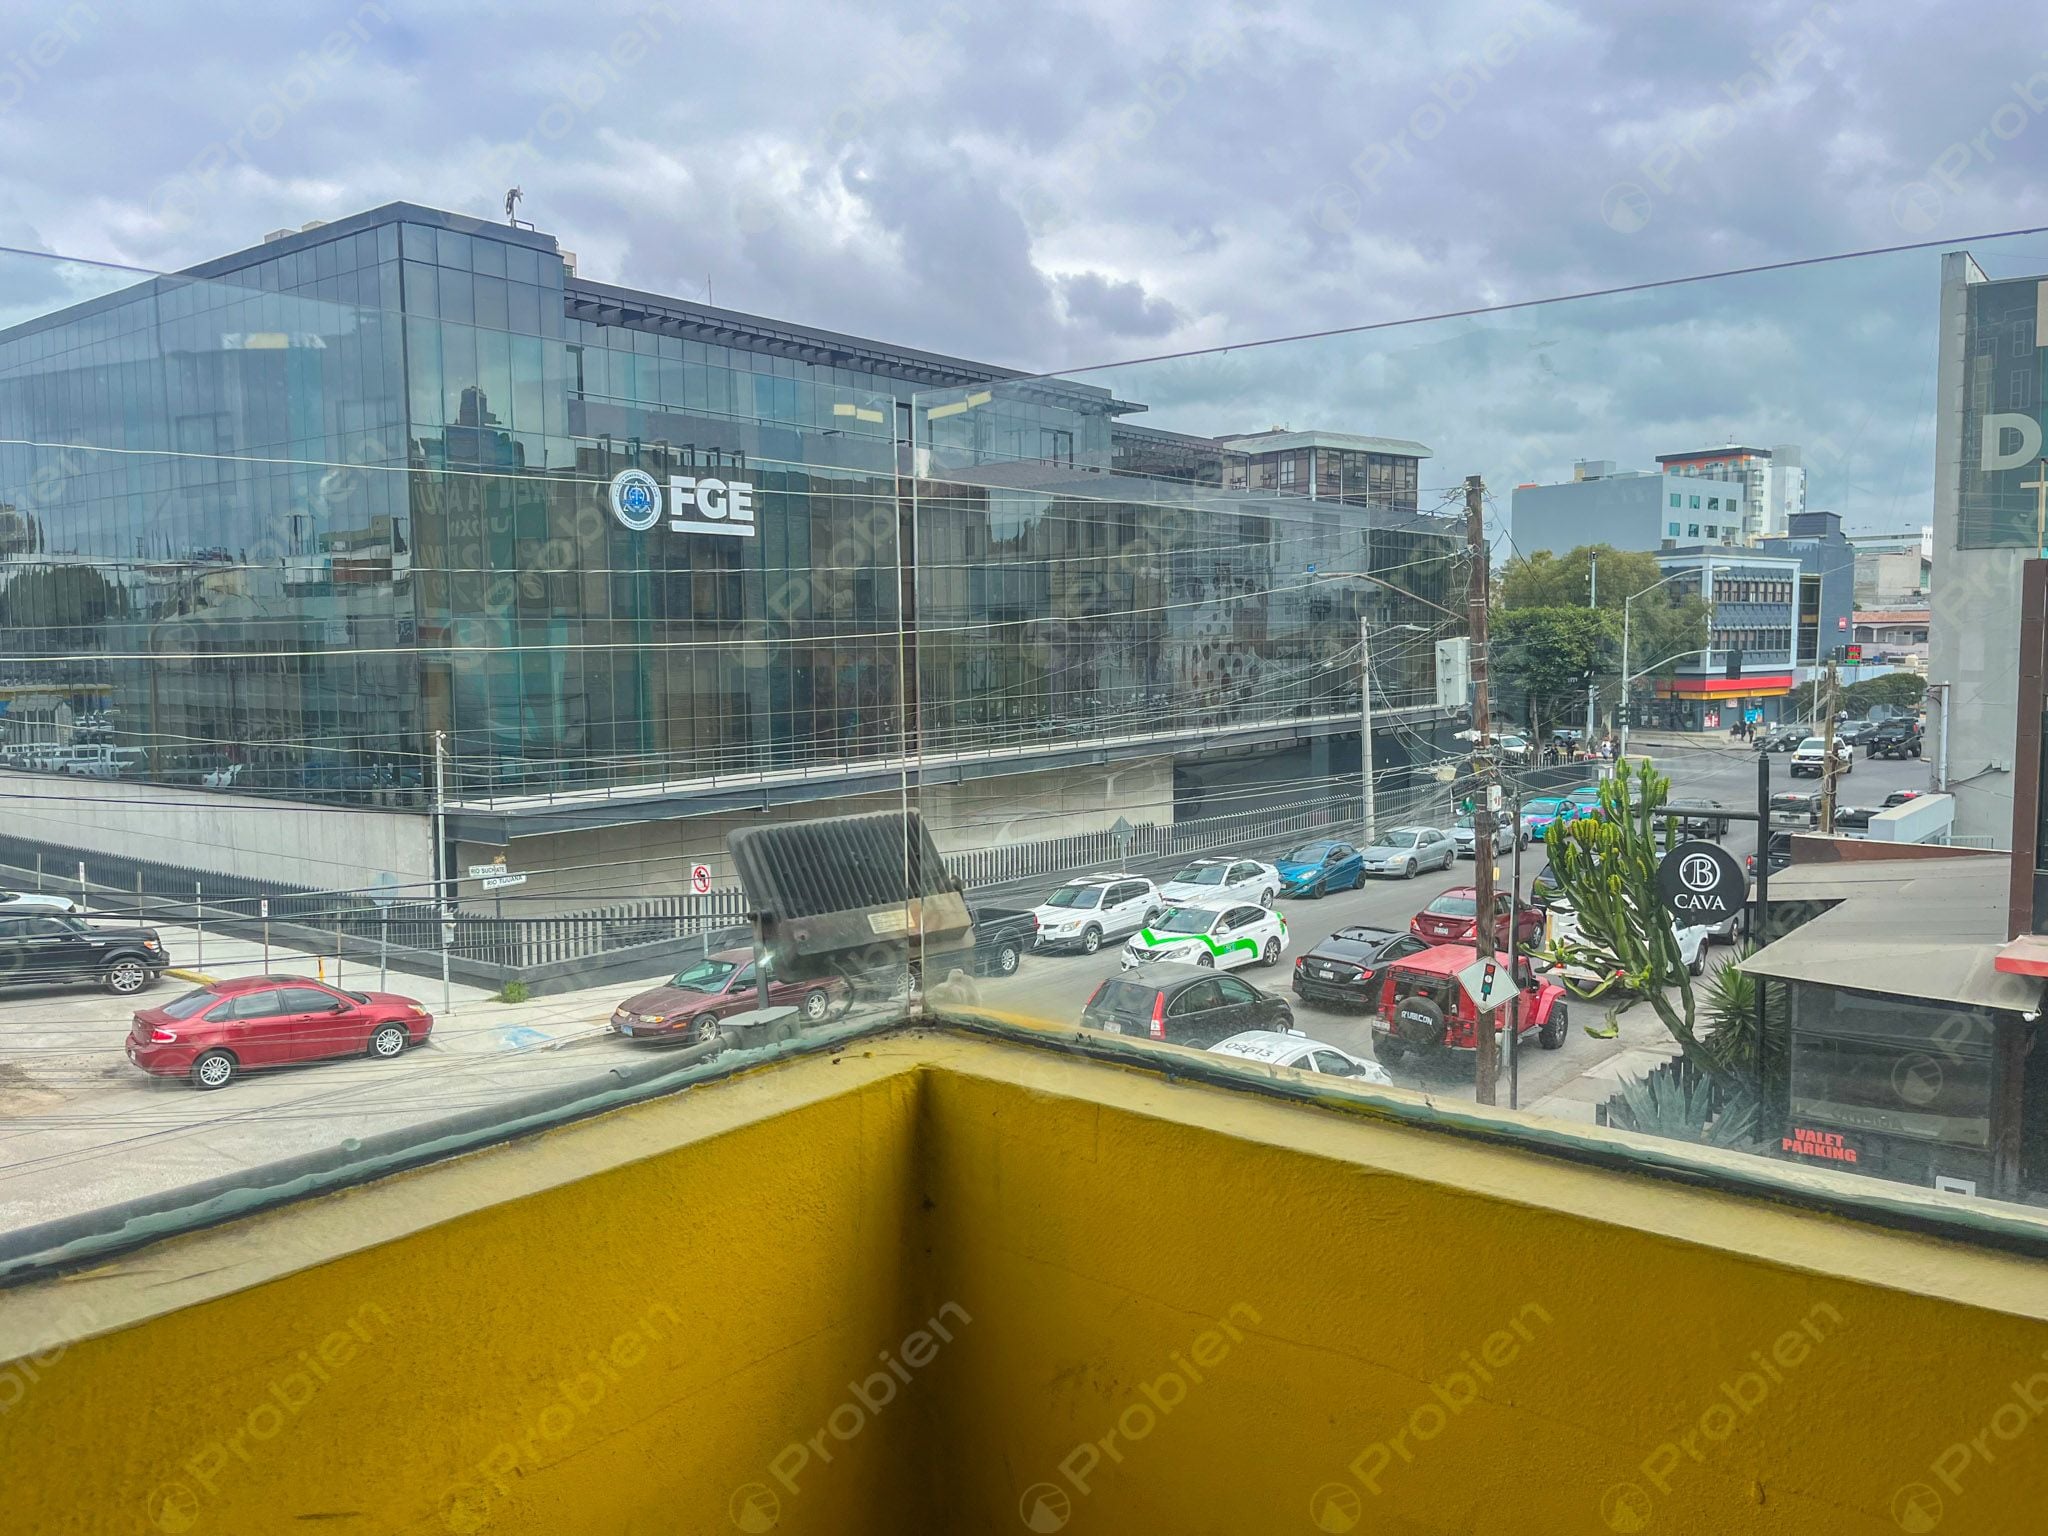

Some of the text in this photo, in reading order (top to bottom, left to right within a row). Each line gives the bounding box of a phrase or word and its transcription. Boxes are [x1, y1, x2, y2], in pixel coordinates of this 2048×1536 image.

[670, 475, 754, 521] FGE
[1674, 894, 1727, 911] CAVA
[1401, 1010, 1433, 1026] RUBICON
[1794, 1128, 1844, 1147] VALET
[1782, 1138, 1857, 1162] PARKING
